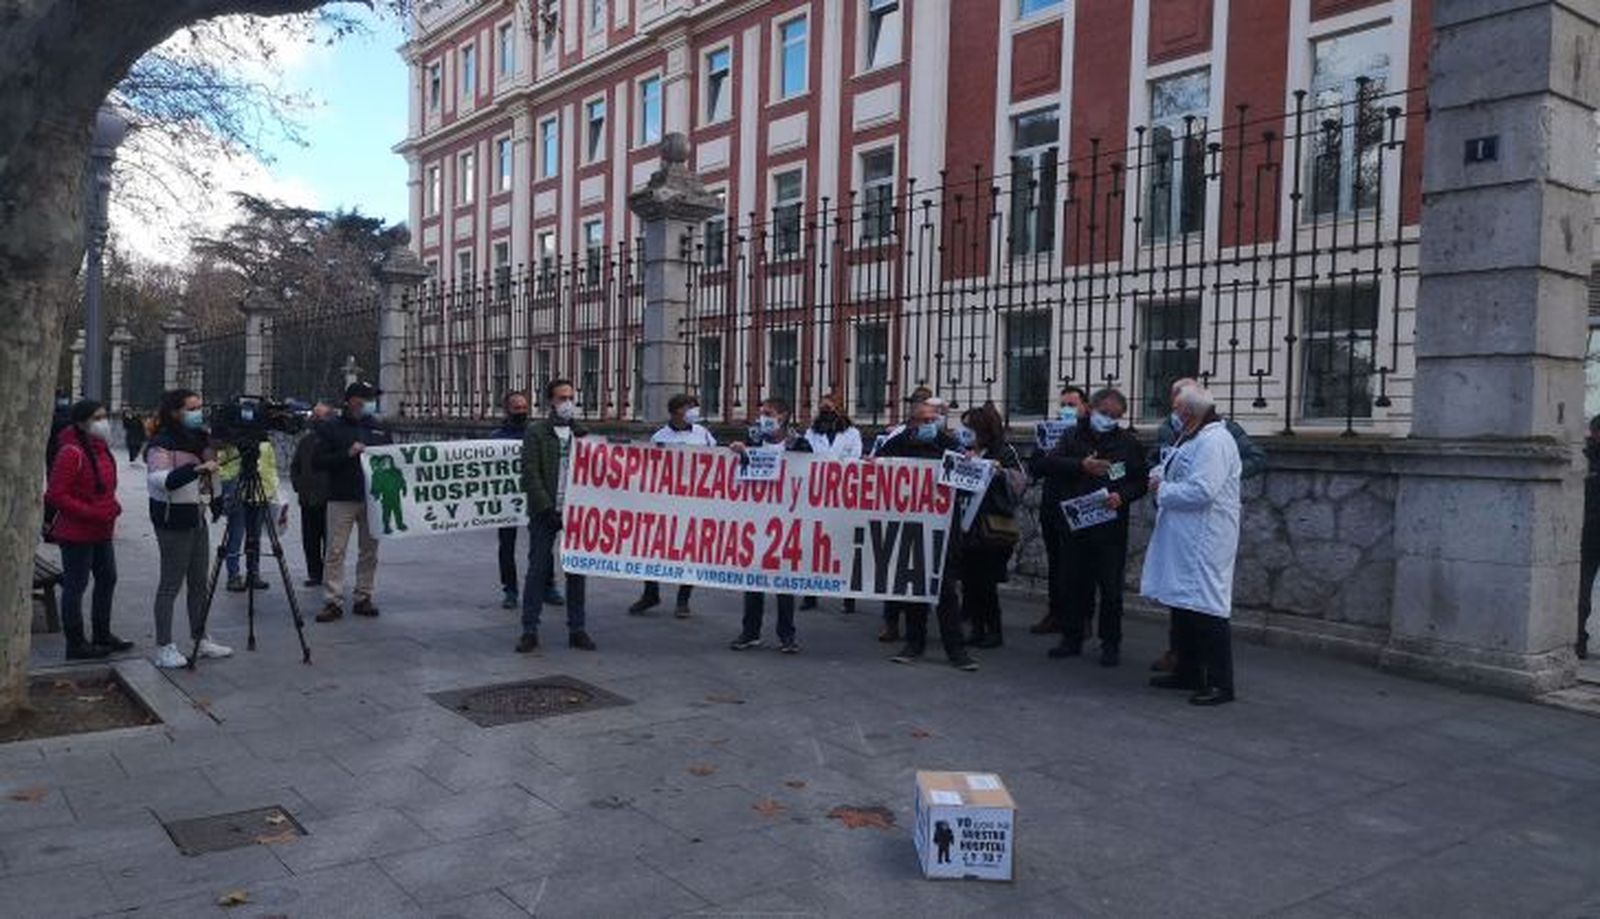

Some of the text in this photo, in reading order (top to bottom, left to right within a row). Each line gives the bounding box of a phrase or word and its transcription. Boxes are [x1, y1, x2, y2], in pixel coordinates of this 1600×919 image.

[400, 444, 522, 464] YO LUCHO PO
[416, 459, 523, 482] NUESTRO
[788, 476, 803, 513] y
[809, 461, 951, 515] URGENCIAS
[445, 503, 459, 518] Y
[565, 505, 756, 568] HOSPITALARIAS
[762, 516, 803, 572] 24
[812, 520, 841, 574] h.
[562, 554, 620, 573] HOSPITAL
[625, 561, 642, 575] DE
[746, 572, 770, 588] DEL
